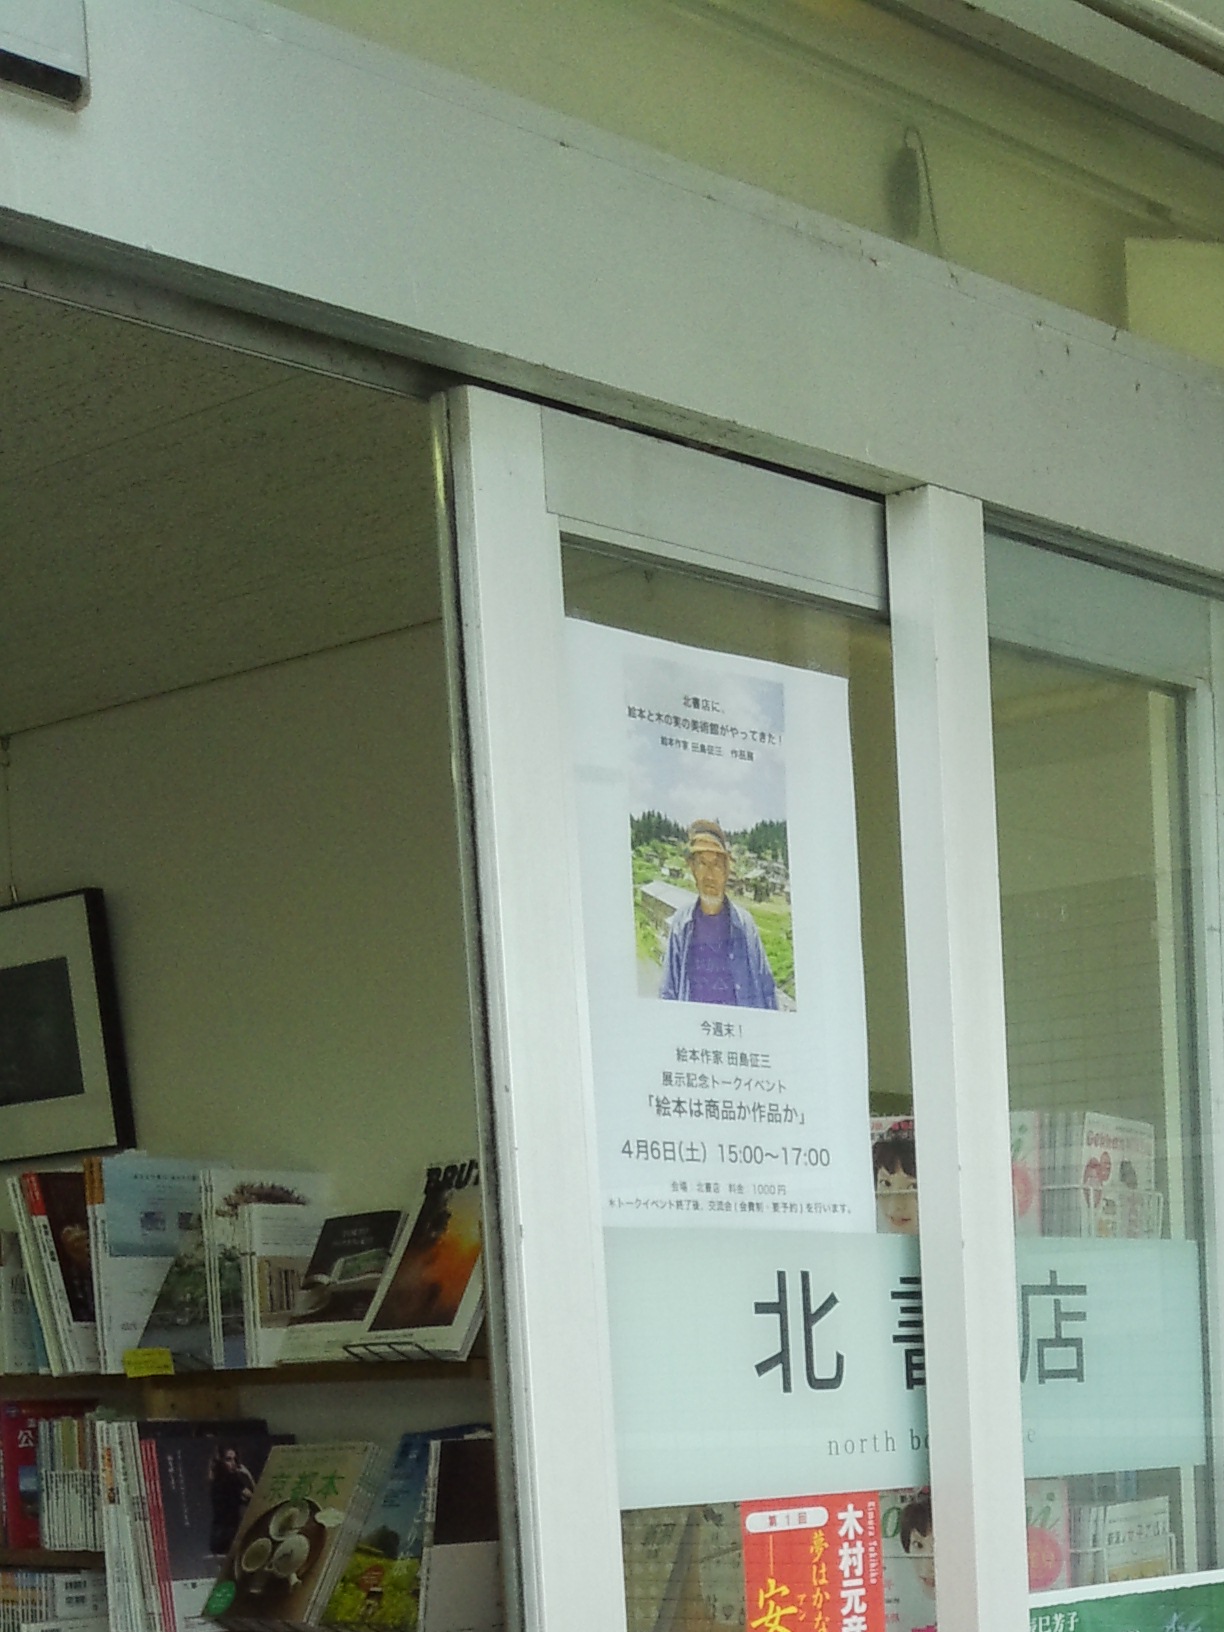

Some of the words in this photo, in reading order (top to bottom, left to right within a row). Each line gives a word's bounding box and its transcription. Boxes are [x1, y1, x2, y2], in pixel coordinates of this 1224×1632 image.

[676, 1047, 723, 1066] 絵本作家
[727, 1052, 771, 1069] 田島征三
[662, 1072, 787, 1093] 展示記念トークイベント
[648, 1095, 806, 1125] 「絵本は商品か作品か」
[621, 1140, 706, 1163] 4月6日(土)
[827, 1430, 896, 1456] north
